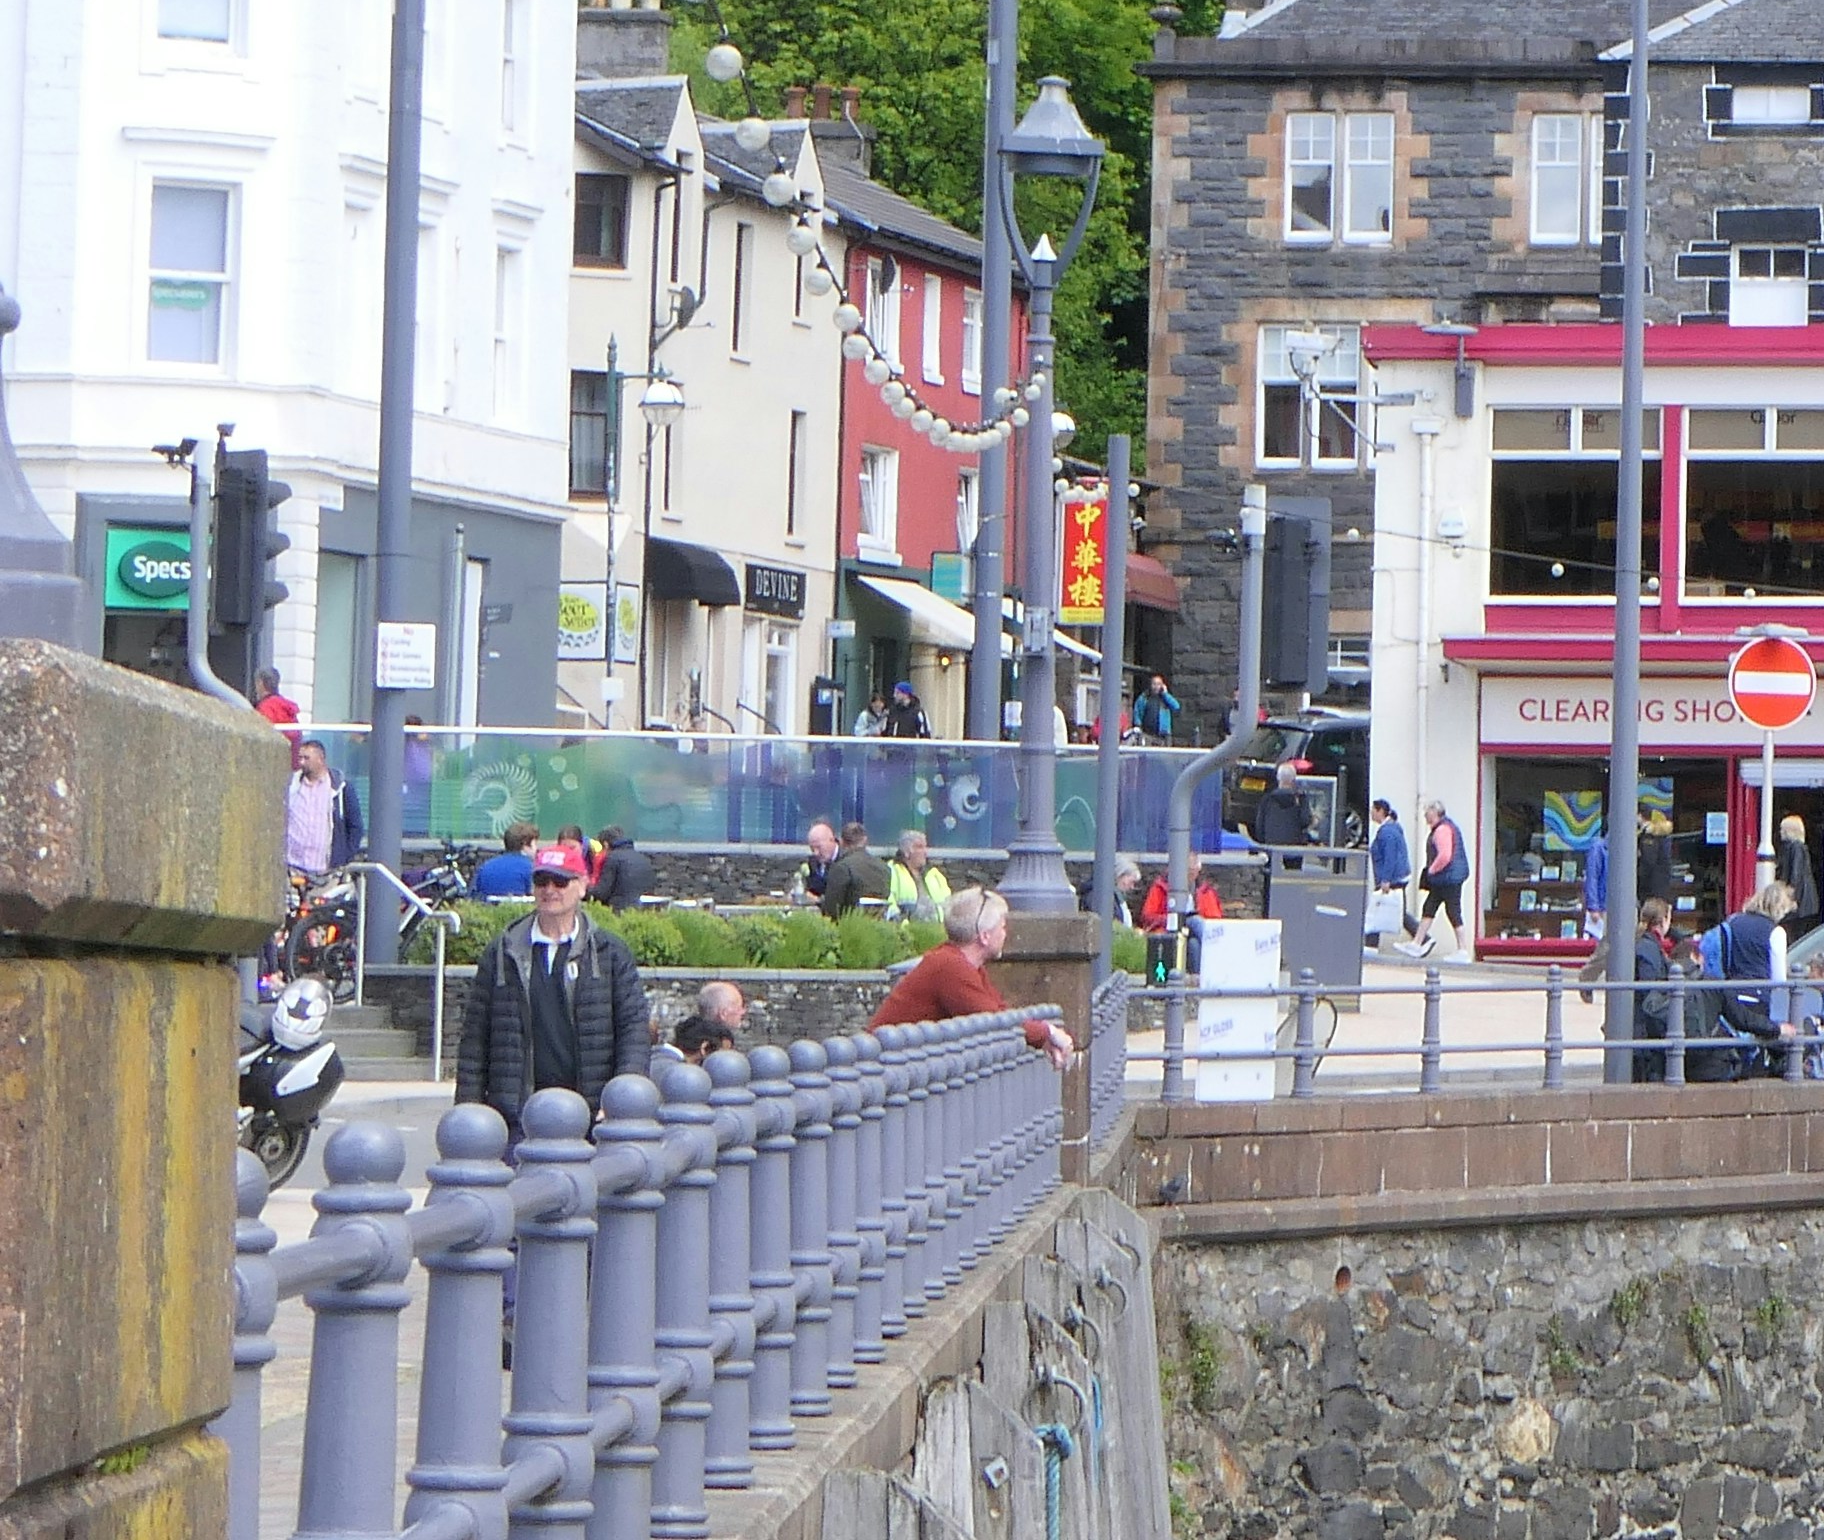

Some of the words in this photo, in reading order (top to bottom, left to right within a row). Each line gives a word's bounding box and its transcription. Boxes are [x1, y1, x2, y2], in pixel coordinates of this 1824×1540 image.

[755, 569, 798, 602] DEVINE
[1518, 698, 1665, 723] CLEARG
[1674, 698, 1746, 723] SHO
